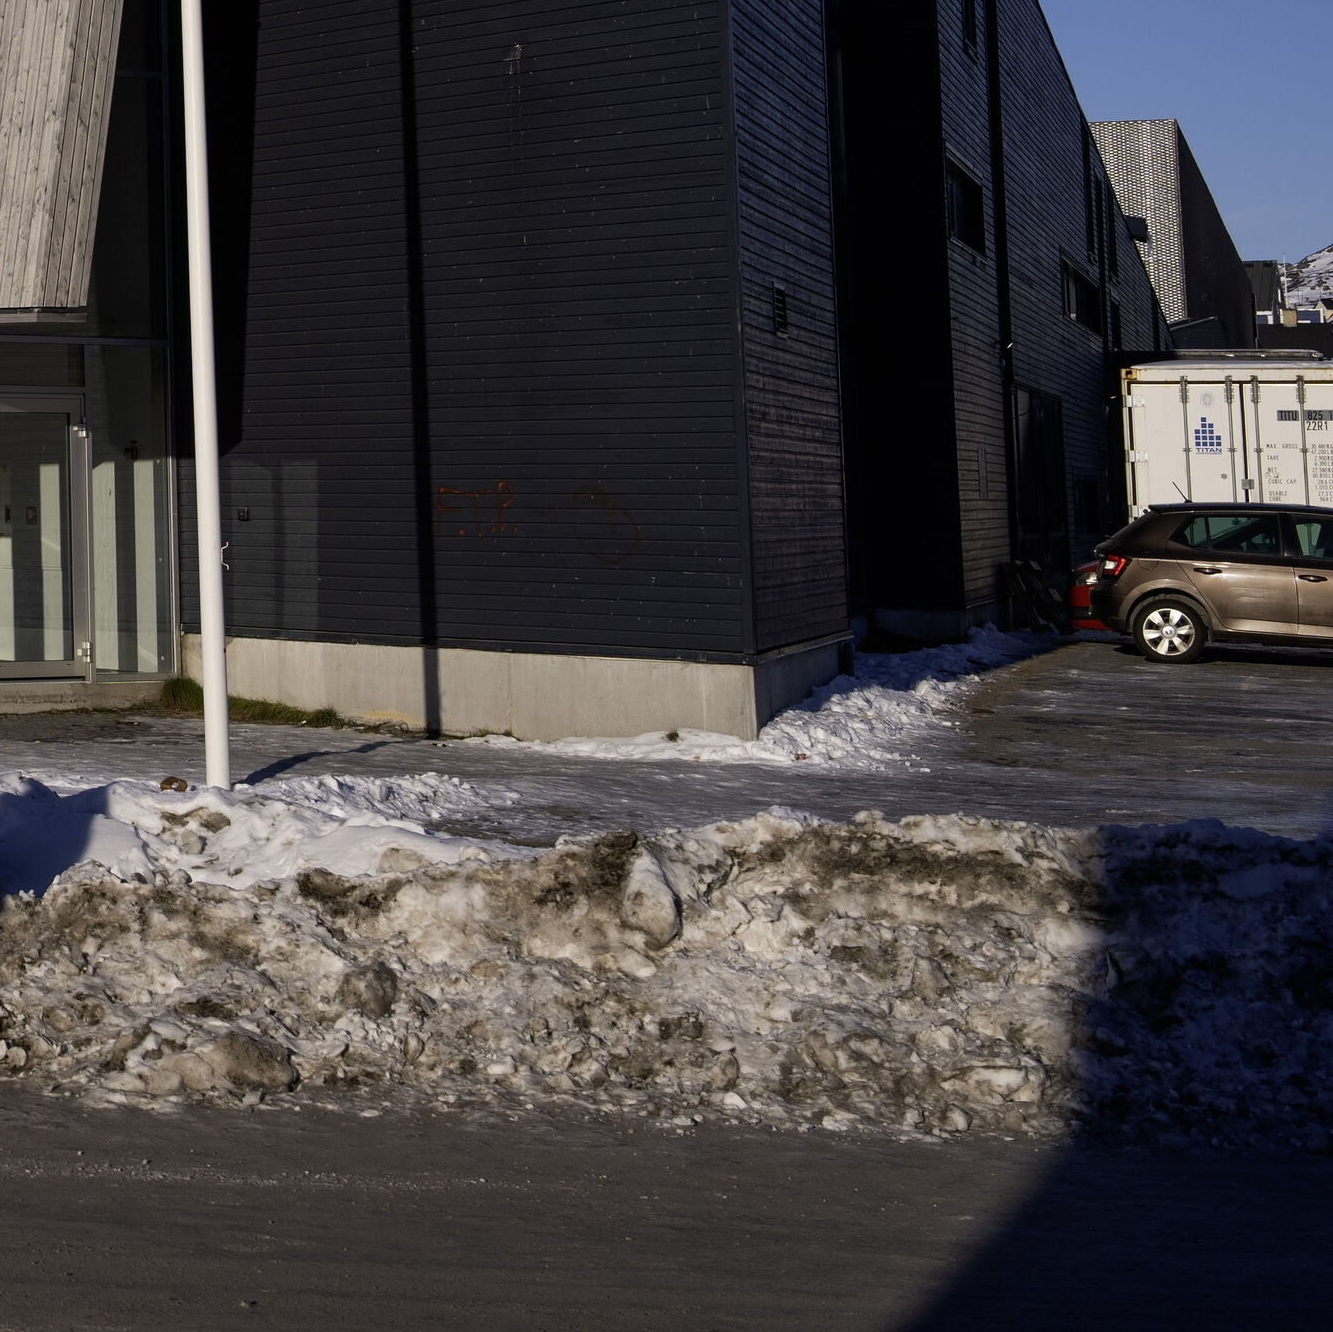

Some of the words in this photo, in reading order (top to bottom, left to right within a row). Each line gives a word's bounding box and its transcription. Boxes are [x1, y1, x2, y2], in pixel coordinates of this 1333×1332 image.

[1279, 410, 1297, 421] TITU
[1307, 410, 1323, 421] 825
[1306, 421, 1328, 431] 22R1
